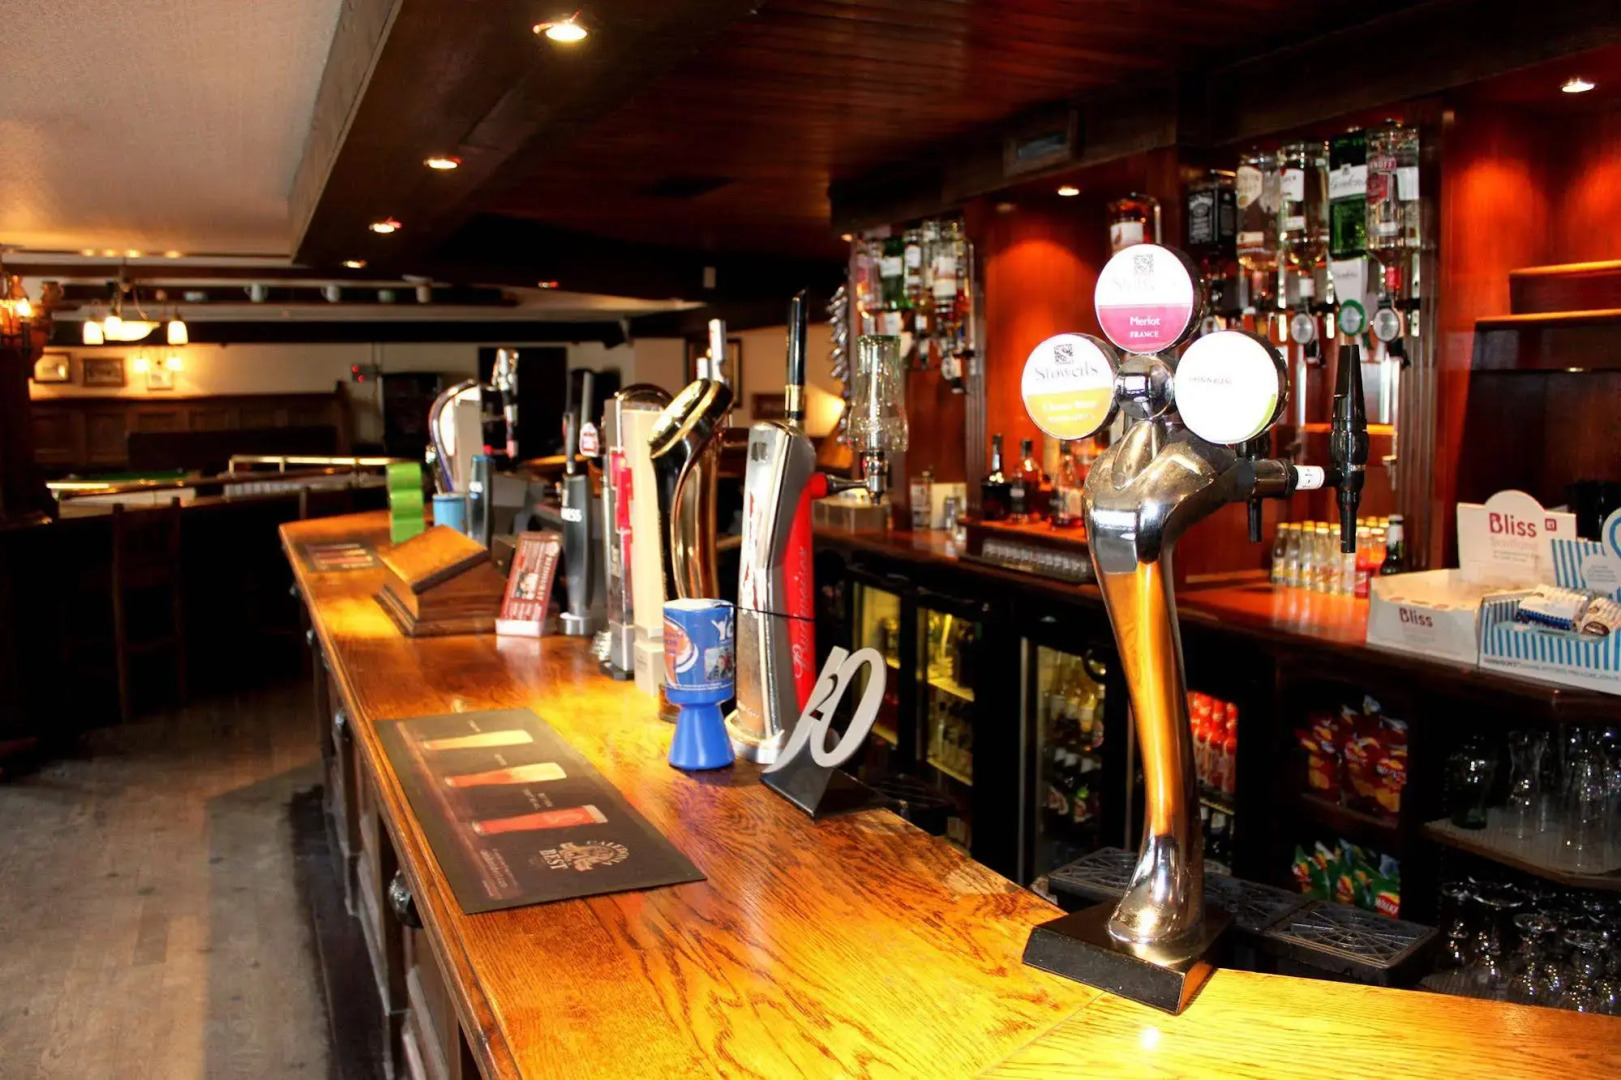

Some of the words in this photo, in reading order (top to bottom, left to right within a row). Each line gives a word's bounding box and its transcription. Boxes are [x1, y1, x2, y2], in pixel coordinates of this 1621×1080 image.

[1129, 316, 1160, 326] Merlot
[1129, 330, 1159, 338] FRANCE
[1488, 512, 1537, 538] Bliss
[1398, 607, 1434, 628] Bliss
[537, 848, 569, 870] BEST
